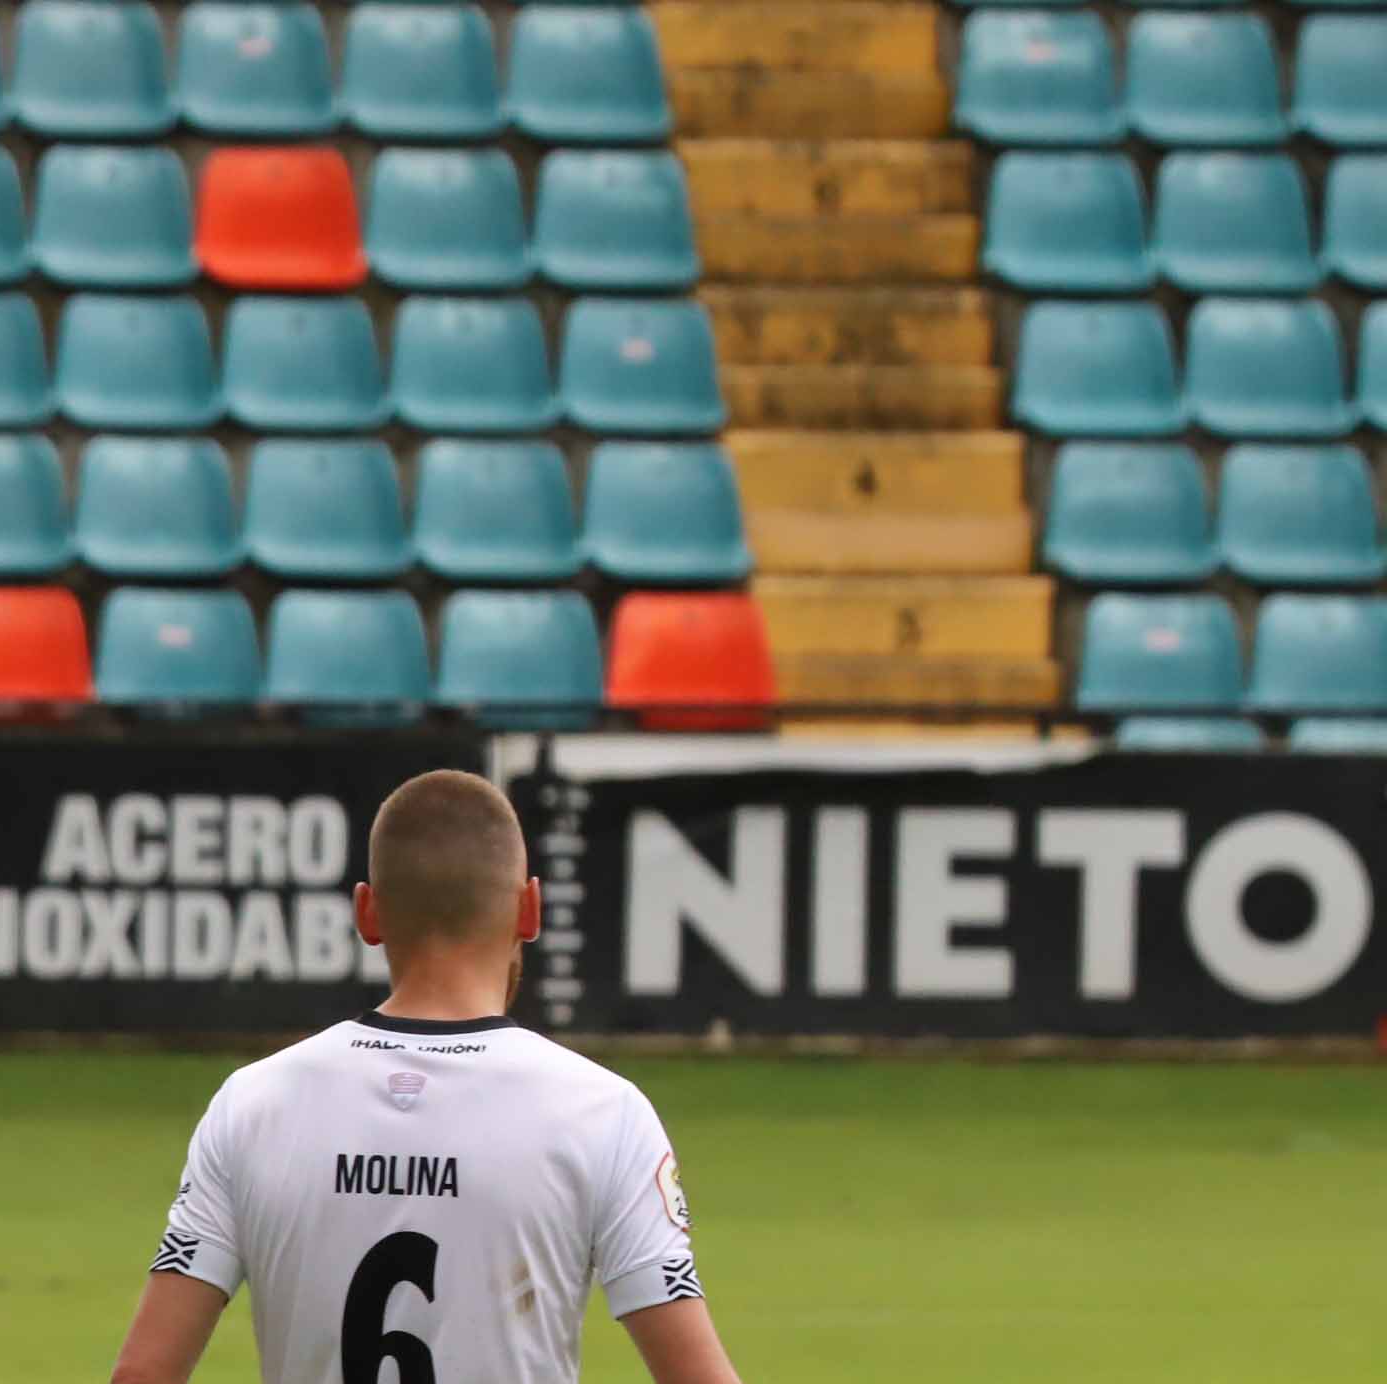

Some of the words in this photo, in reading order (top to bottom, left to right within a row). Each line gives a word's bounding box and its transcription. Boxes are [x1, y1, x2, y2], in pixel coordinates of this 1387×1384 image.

[41, 794, 349, 886] ACERO
[623, 806, 1373, 1002] NIETO
[335, 1153, 459, 1197] MOLINA
